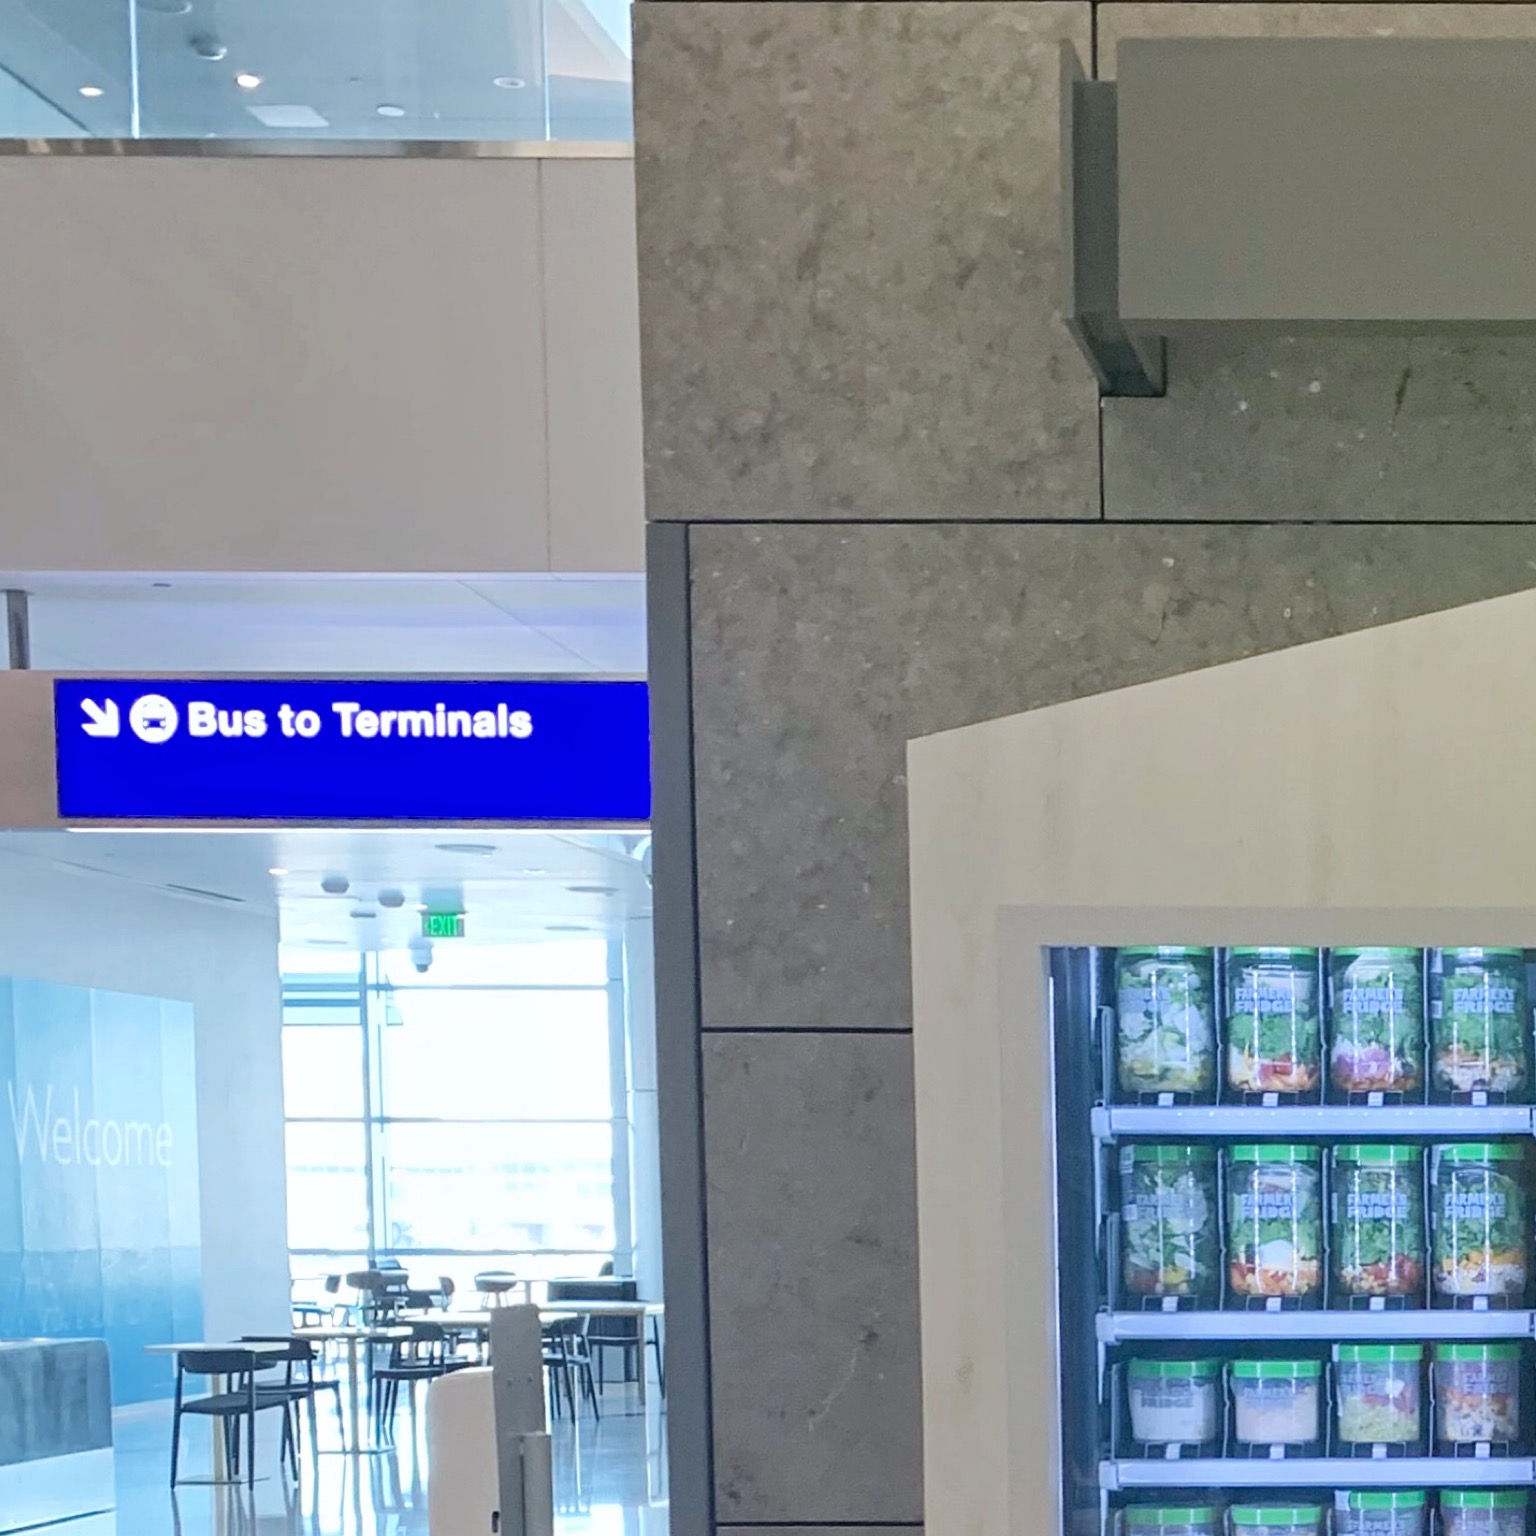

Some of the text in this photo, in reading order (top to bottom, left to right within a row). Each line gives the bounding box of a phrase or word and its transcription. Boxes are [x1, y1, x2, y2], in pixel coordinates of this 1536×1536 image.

[188, 701, 533, 738] Bus to Terminals
[430, 915, 457, 936] EXIT
[1453, 1001, 1515, 1013] FRIDGE
[8, 1080, 173, 1167] Welcome
